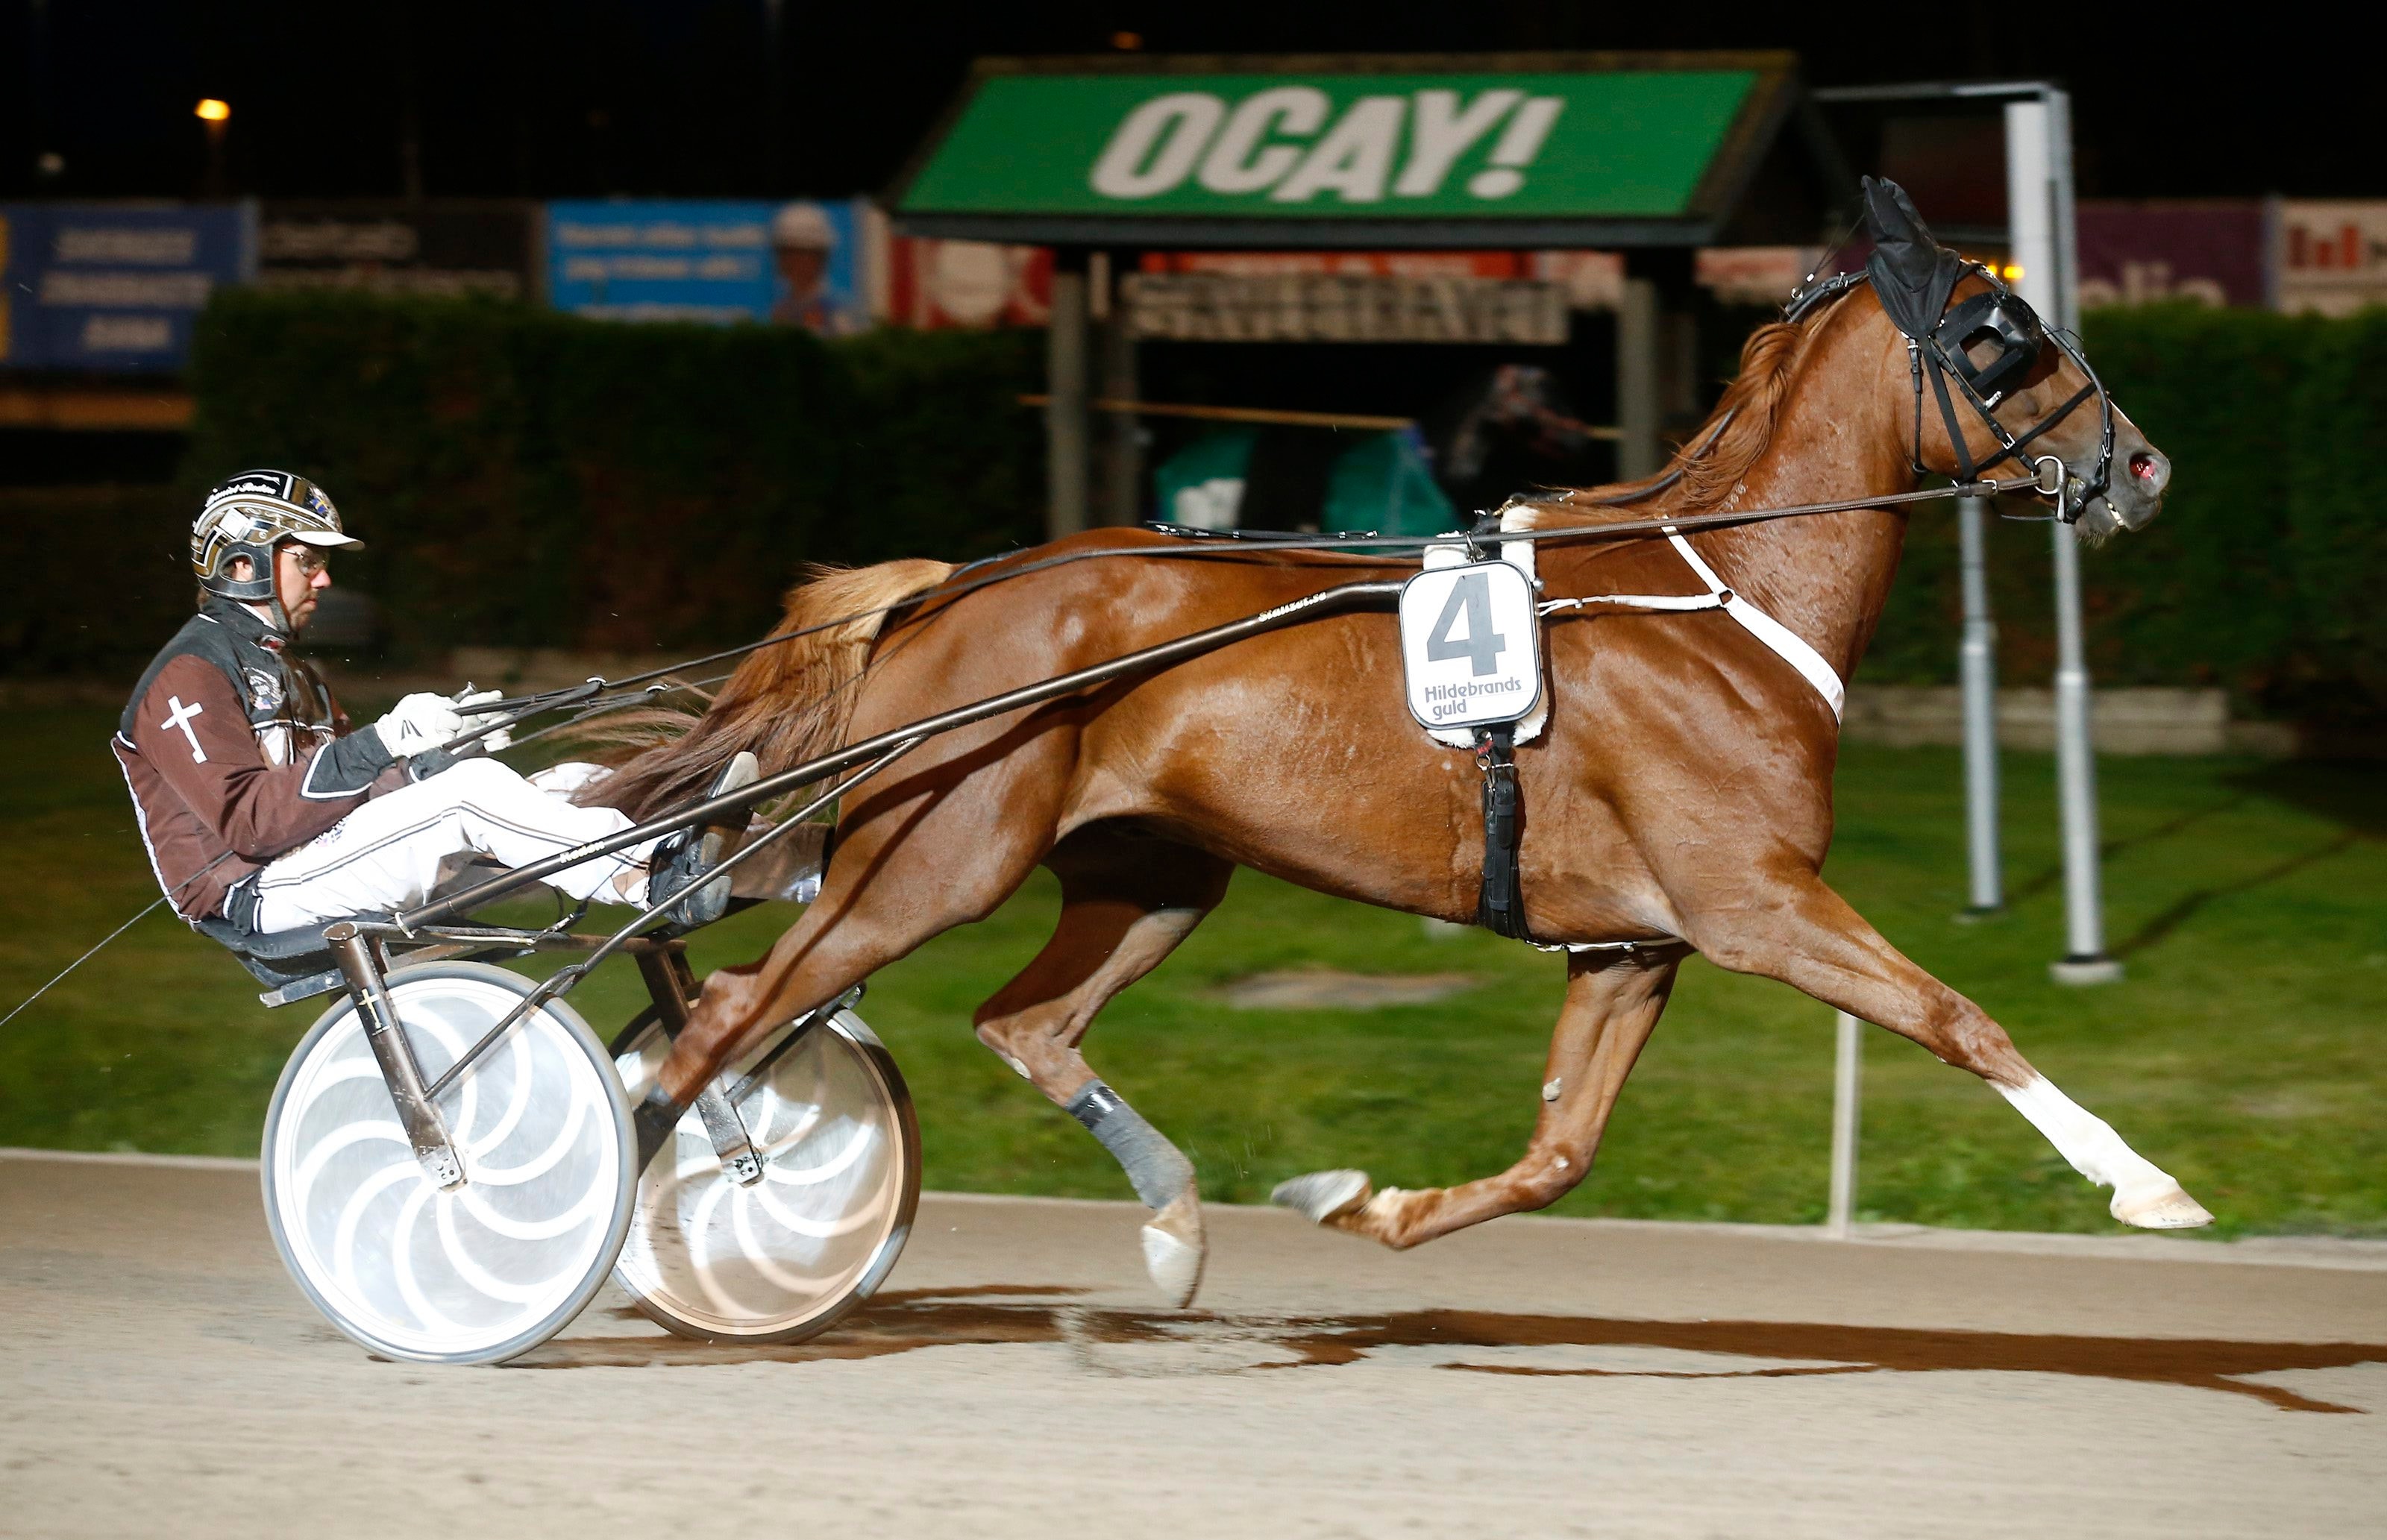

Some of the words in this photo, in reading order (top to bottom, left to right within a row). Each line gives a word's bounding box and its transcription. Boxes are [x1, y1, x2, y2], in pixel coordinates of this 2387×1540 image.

[1089, 86, 1564, 202] OCAY!
[1426, 572, 1506, 677] 4
[1425, 676, 1522, 703] Hildebrands
[1432, 699, 1467, 720] guld
